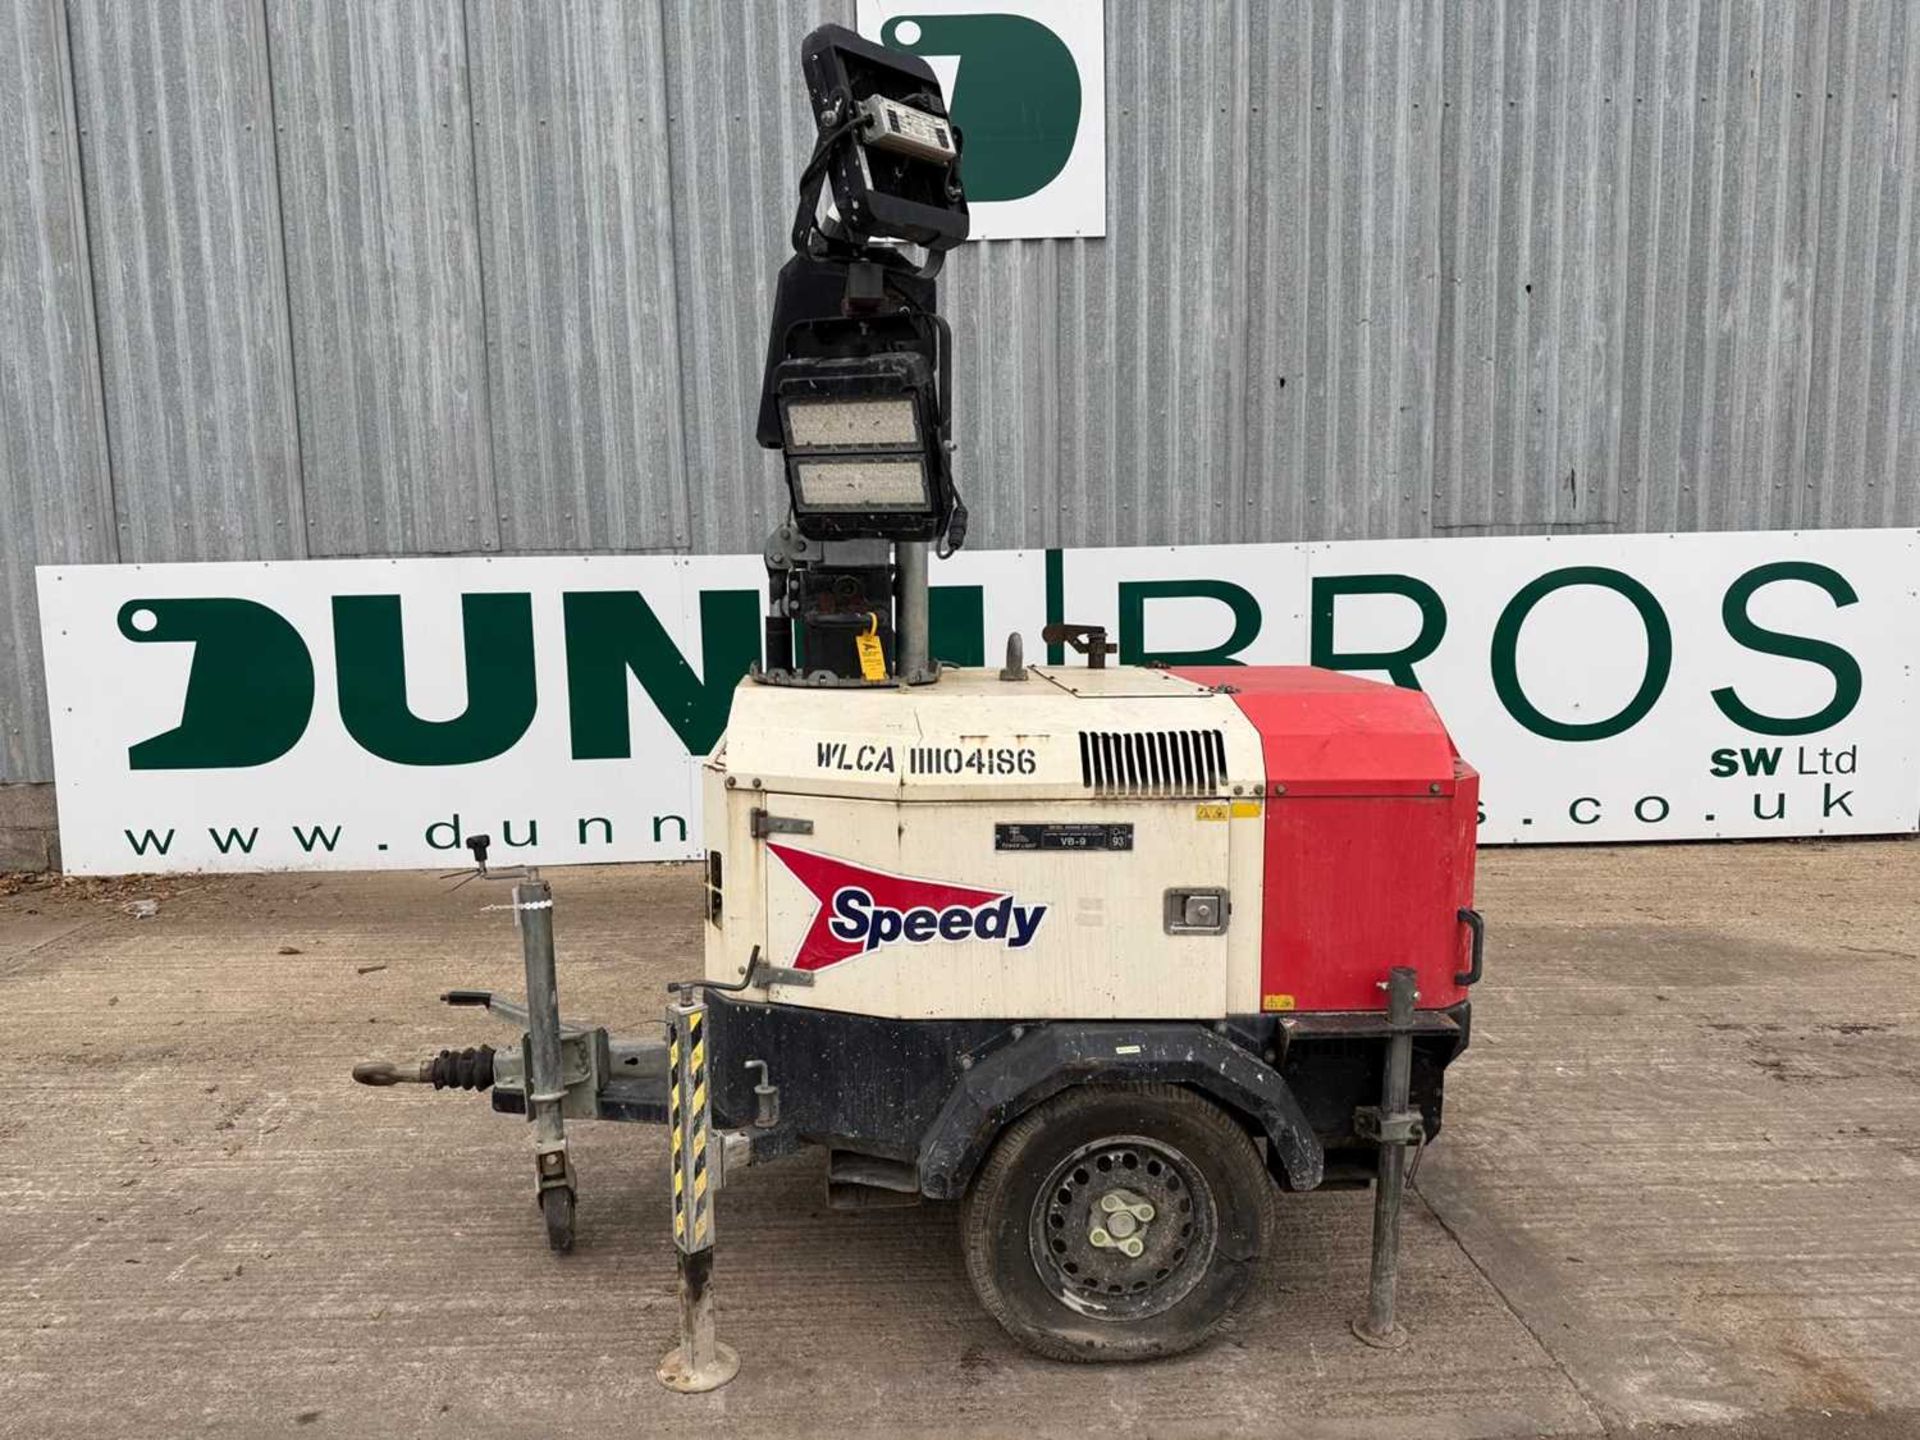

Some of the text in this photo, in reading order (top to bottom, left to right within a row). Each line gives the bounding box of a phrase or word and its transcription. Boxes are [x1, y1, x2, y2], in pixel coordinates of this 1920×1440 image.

[117, 584, 984, 770] DUN
[817, 742, 895, 773] WLCA
[1710, 744, 1858, 778] SW Ltd
[1112, 836, 1125, 848] 93
[831, 888, 1048, 951] Speedy
